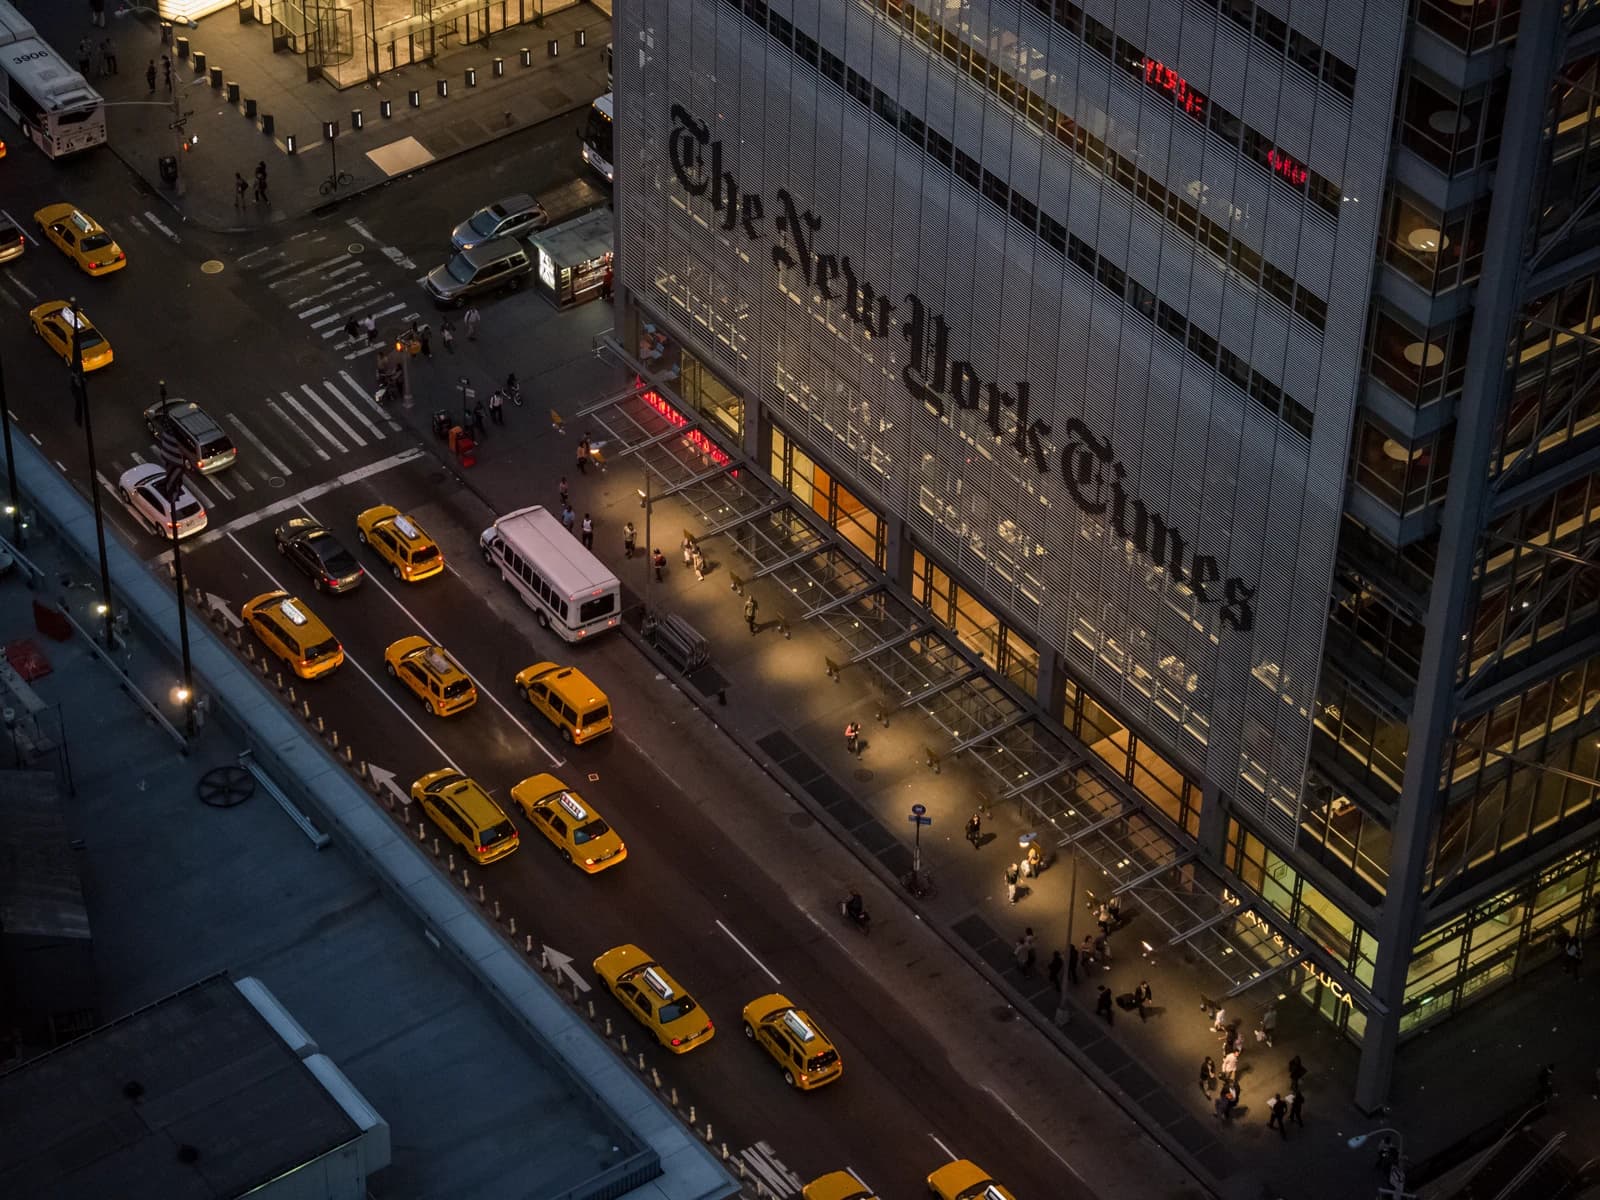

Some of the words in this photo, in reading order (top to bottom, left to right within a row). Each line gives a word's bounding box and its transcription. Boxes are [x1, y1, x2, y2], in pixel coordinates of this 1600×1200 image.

[13, 50, 49, 65] 3906
[669, 103, 764, 240] The
[772, 188, 896, 340] New
[902, 294, 1055, 473] York
[1061, 418, 1256, 631] Times
